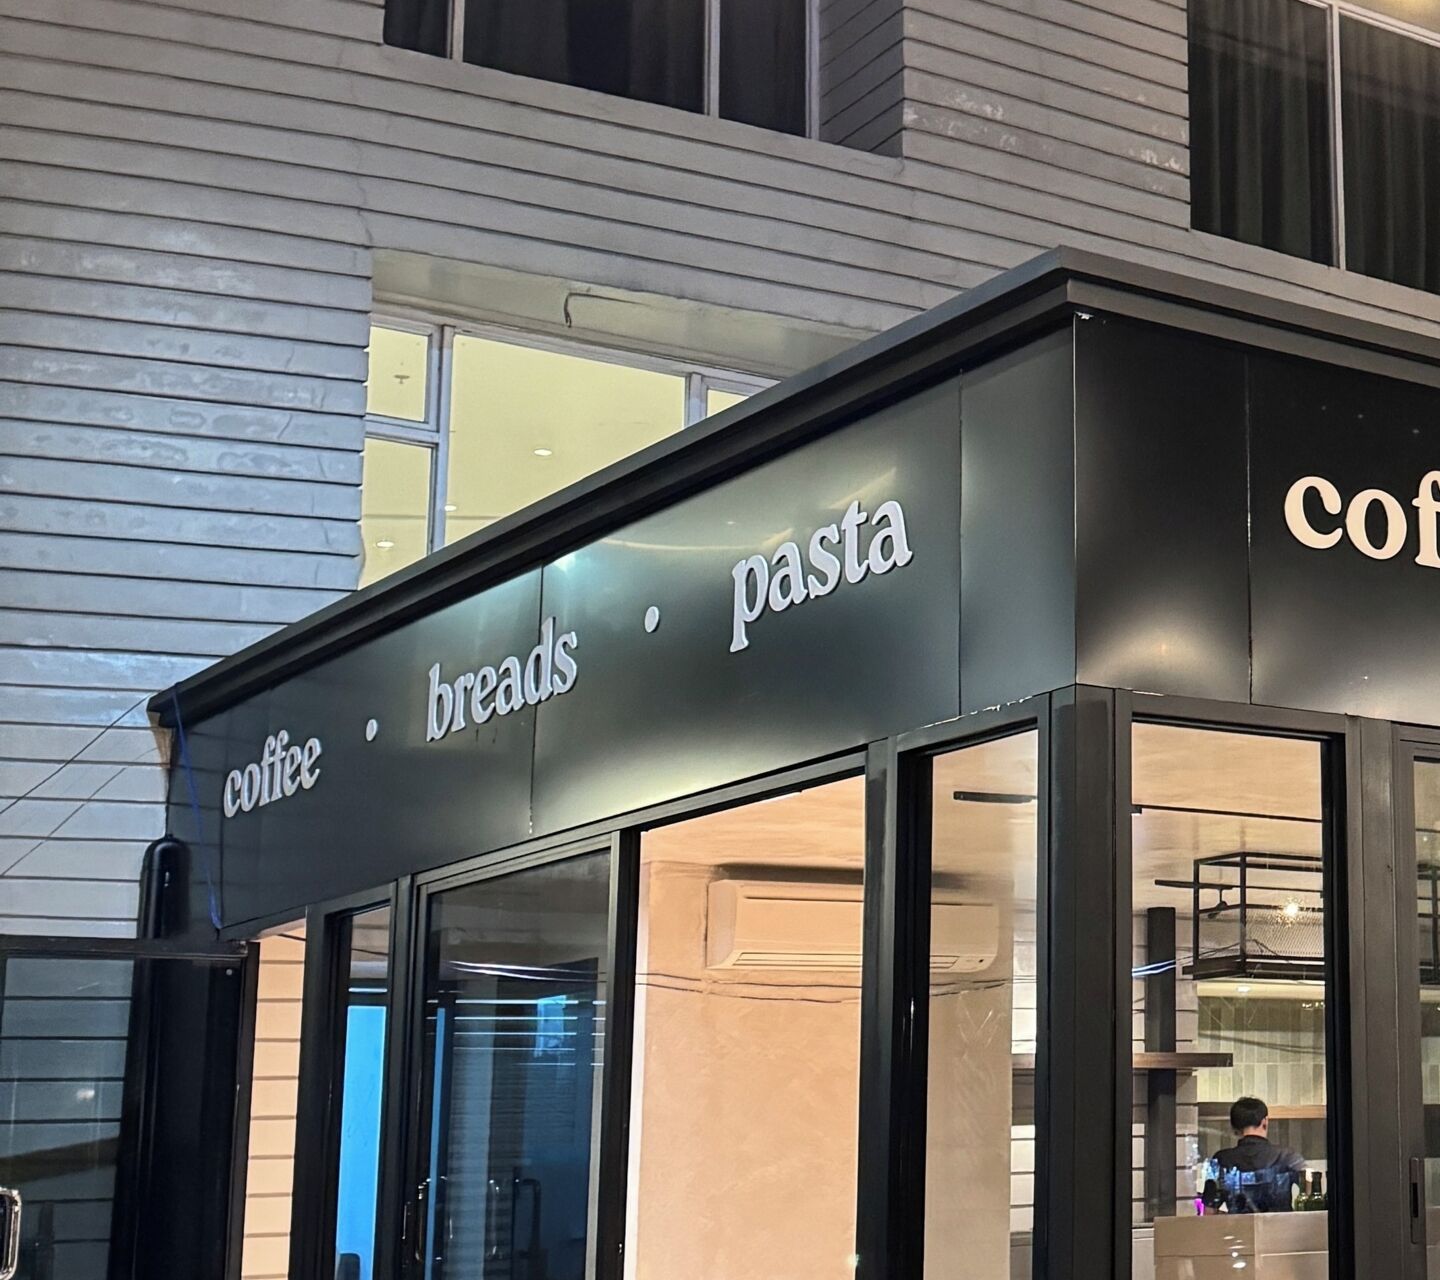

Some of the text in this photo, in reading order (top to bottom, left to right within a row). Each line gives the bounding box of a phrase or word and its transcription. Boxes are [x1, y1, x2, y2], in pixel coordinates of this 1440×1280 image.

[222, 500, 913, 818] coffee breads pasta
